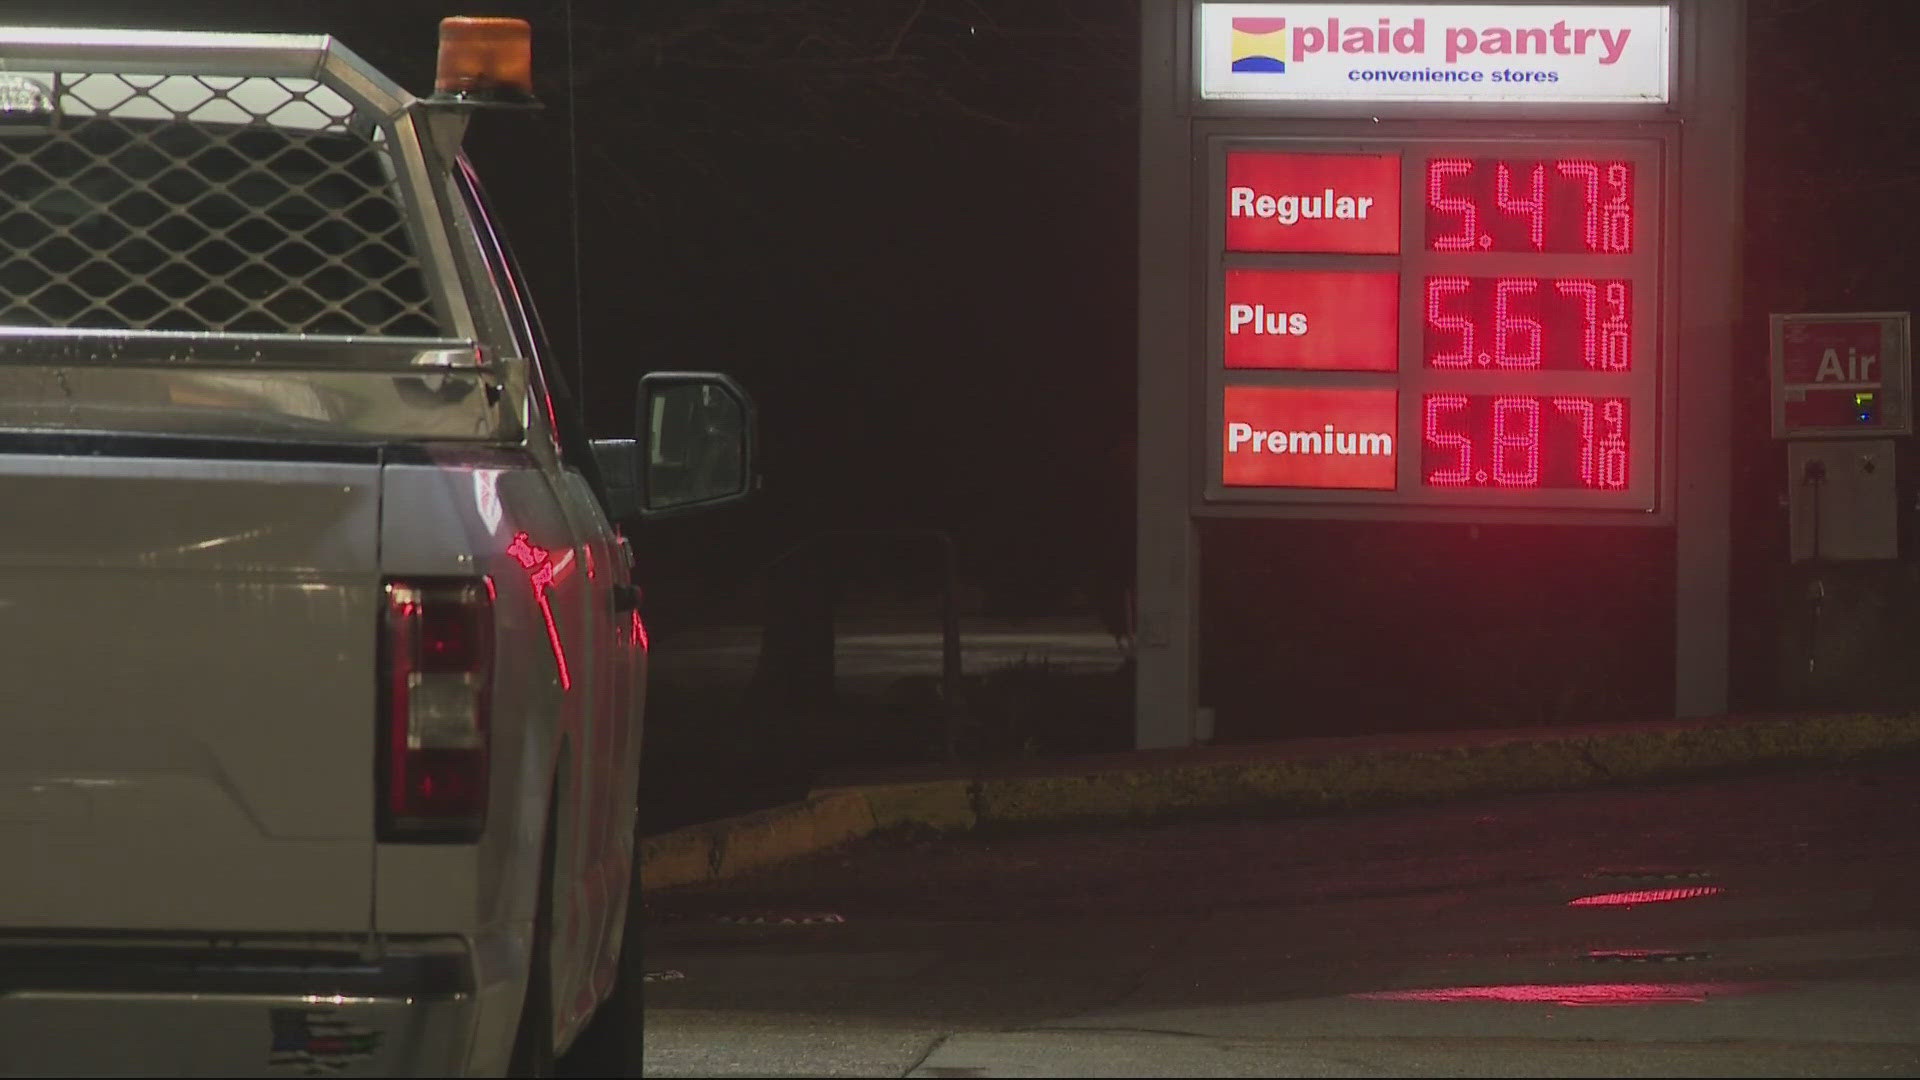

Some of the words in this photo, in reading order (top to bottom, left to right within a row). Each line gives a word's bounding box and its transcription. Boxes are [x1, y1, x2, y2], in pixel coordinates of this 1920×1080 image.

[1292, 18, 1426, 62] plaid
[1446, 19, 1631, 65] pantry
[1348, 67, 1484, 83] convenience
[1491, 68, 1559, 83] stores
[1230, 187, 1373, 225] Regular
[1430, 159, 1598, 251] 5.47
[1229, 304, 1308, 336] Plus
[1428, 278, 1597, 368] 5.67
[1815, 348, 1875, 382] Air
[1228, 423, 1392, 457] Premium
[1426, 395, 1595, 485] 5.87
